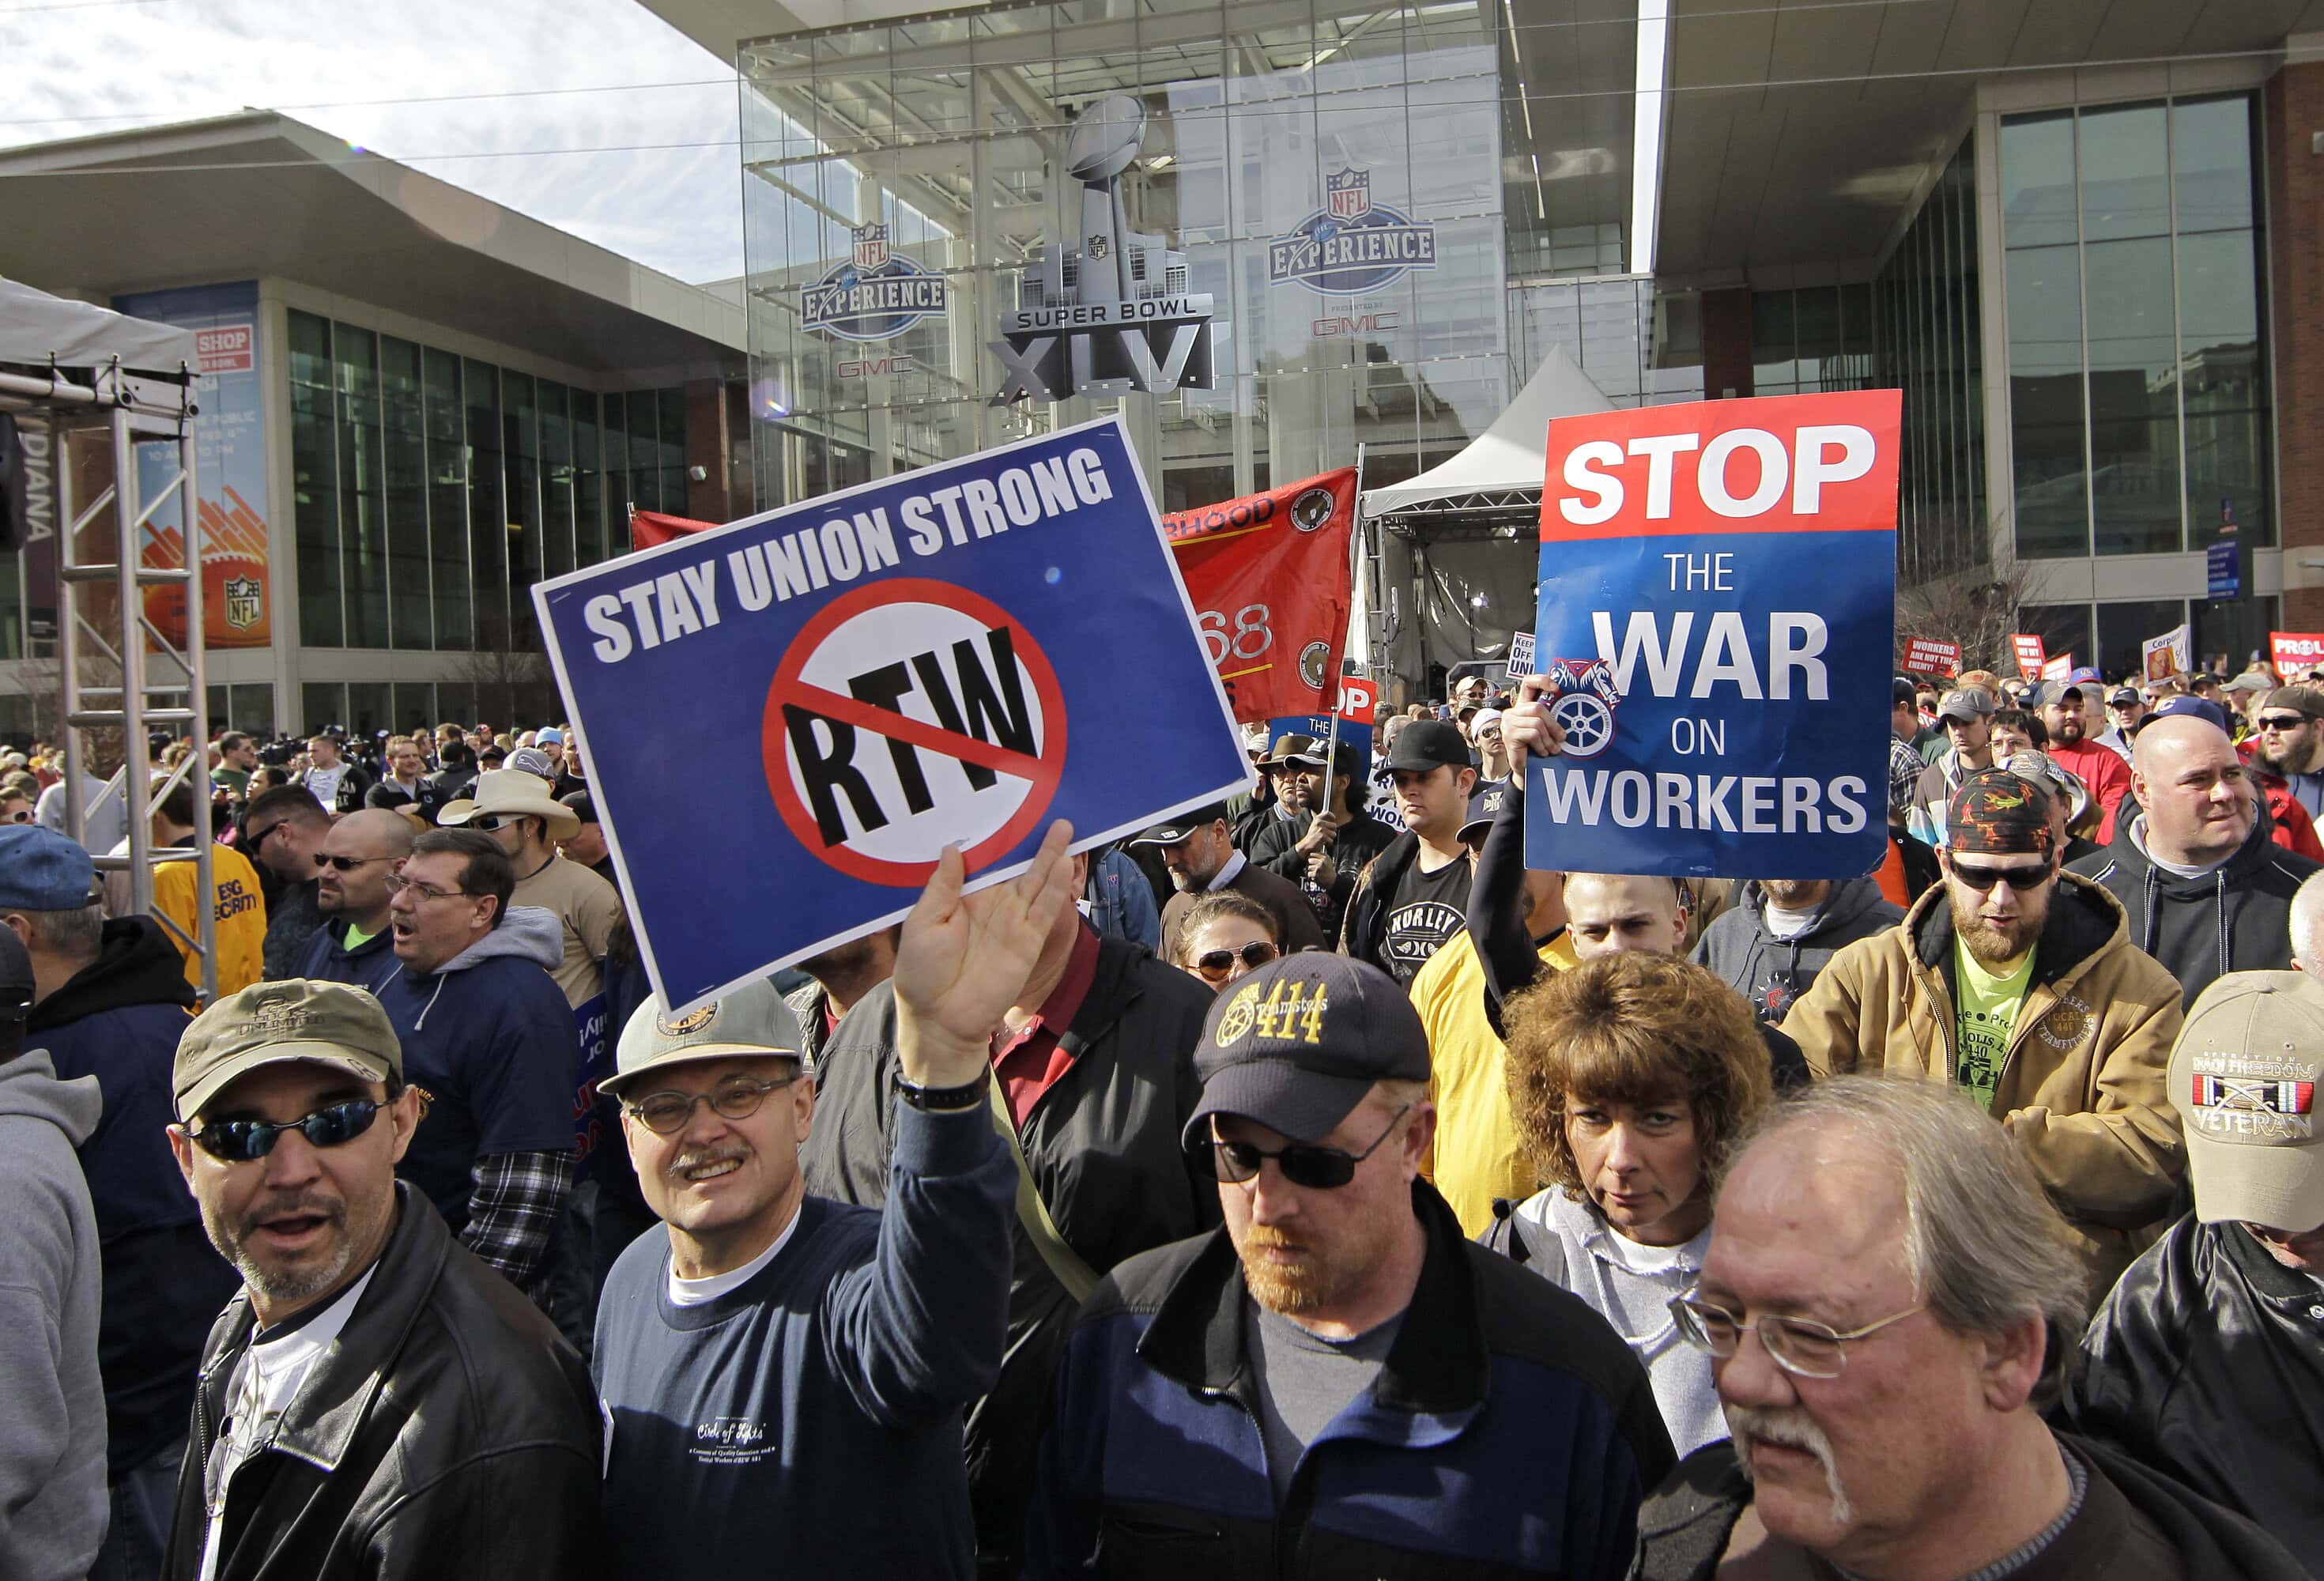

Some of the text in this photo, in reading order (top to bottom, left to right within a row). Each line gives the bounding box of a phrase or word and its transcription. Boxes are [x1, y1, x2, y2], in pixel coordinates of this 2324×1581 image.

[1331, 190, 1367, 216] NFL
[855, 242, 886, 266] NFL
[1088, 245, 1107, 257] NFL
[1273, 231, 1432, 275] EXPERIENCE
[805, 281, 944, 320] EXPERIENCE
[1017, 298, 1198, 329] SUPER BOWL
[1311, 311, 1400, 338] GMC
[198, 331, 247, 353] SHOP
[837, 354, 913, 378] GMC
[987, 322, 1231, 406] XLVI
[23, 433, 53, 543] DIANA
[1559, 424, 1877, 526] STOP
[1162, 497, 1275, 538] RHOOD
[583, 447, 1115, 665] STAY UNION STRONG
[1662, 552, 1734, 593] THE
[228, 599, 260, 624] NFL
[1513, 647, 1532, 661] OFF
[1515, 636, 1534, 648] KEEP
[1912, 640, 1955, 655] WORKERS
[1510, 660, 1534, 676] UNI
[1590, 610, 1829, 701] WAR
[1910, 651, 1953, 666] ARE NOT THE
[781, 625, 1039, 849] RTW
[1308, 718, 1330, 735] THE
[1670, 716, 1726, 757] ON
[1541, 767, 1868, 835] WORKERS
[1391, 907, 1457, 934] HURLEY
[1255, 978, 1327, 1044] 414
[2063, 996, 2091, 1013] BERS
[240, 1015, 326, 1036] UNLIMITED
[1967, 1032, 1995, 1049] OLIS,
[2203, 1051, 2296, 1063] OPERATION
[2228, 1058, 2315, 1080] FREEDOM
[2192, 1108, 2315, 1139] VETERAN
[722, 1422, 736, 1444] of
